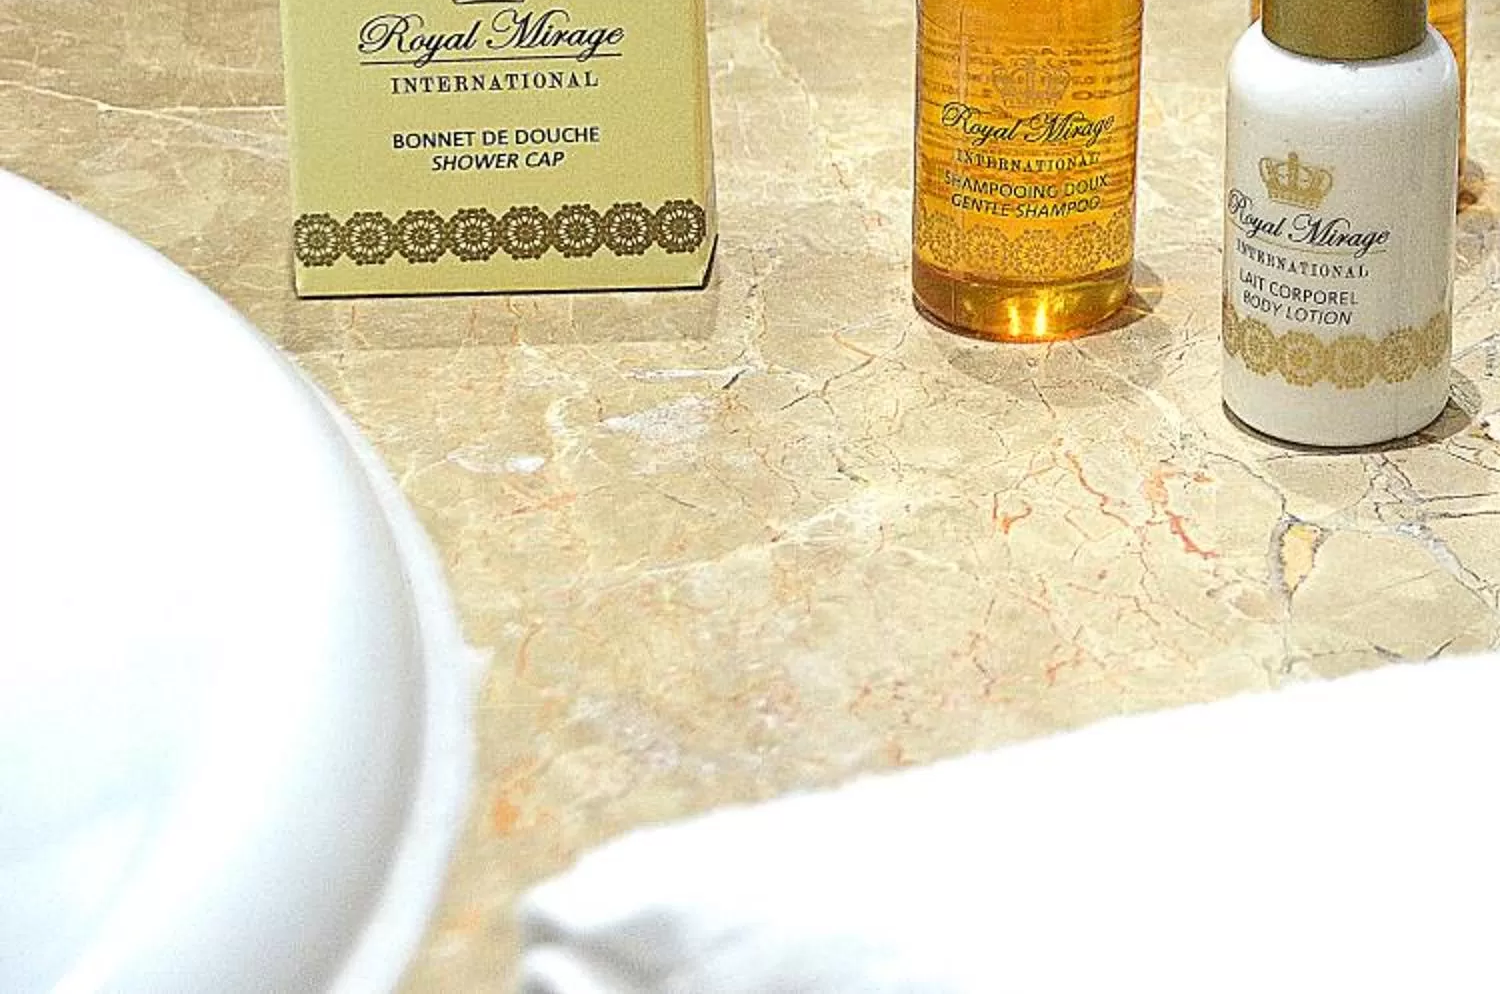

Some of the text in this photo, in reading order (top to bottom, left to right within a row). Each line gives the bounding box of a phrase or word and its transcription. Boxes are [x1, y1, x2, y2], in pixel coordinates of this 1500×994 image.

[358, 8, 623, 68] Royal Mirage
[391, 71, 599, 95] INTERNATIONAL
[393, 126, 599, 149] BONNET DE DOUCHE
[942, 101, 1114, 147] Royal Mirage
[432, 151, 564, 171] SHOWER CAP
[944, 170, 1109, 199] SHAMPOOING DOUX
[951, 193, 1100, 218] GENTLE SHAMPOO
[1228, 188, 1391, 258] Royal Mirage
[1236, 238, 1368, 279] INTERNATIONAL
[1239, 267, 1359, 305] LAIT CORPOREL
[1243, 290, 1352, 325] BODY LOTION
